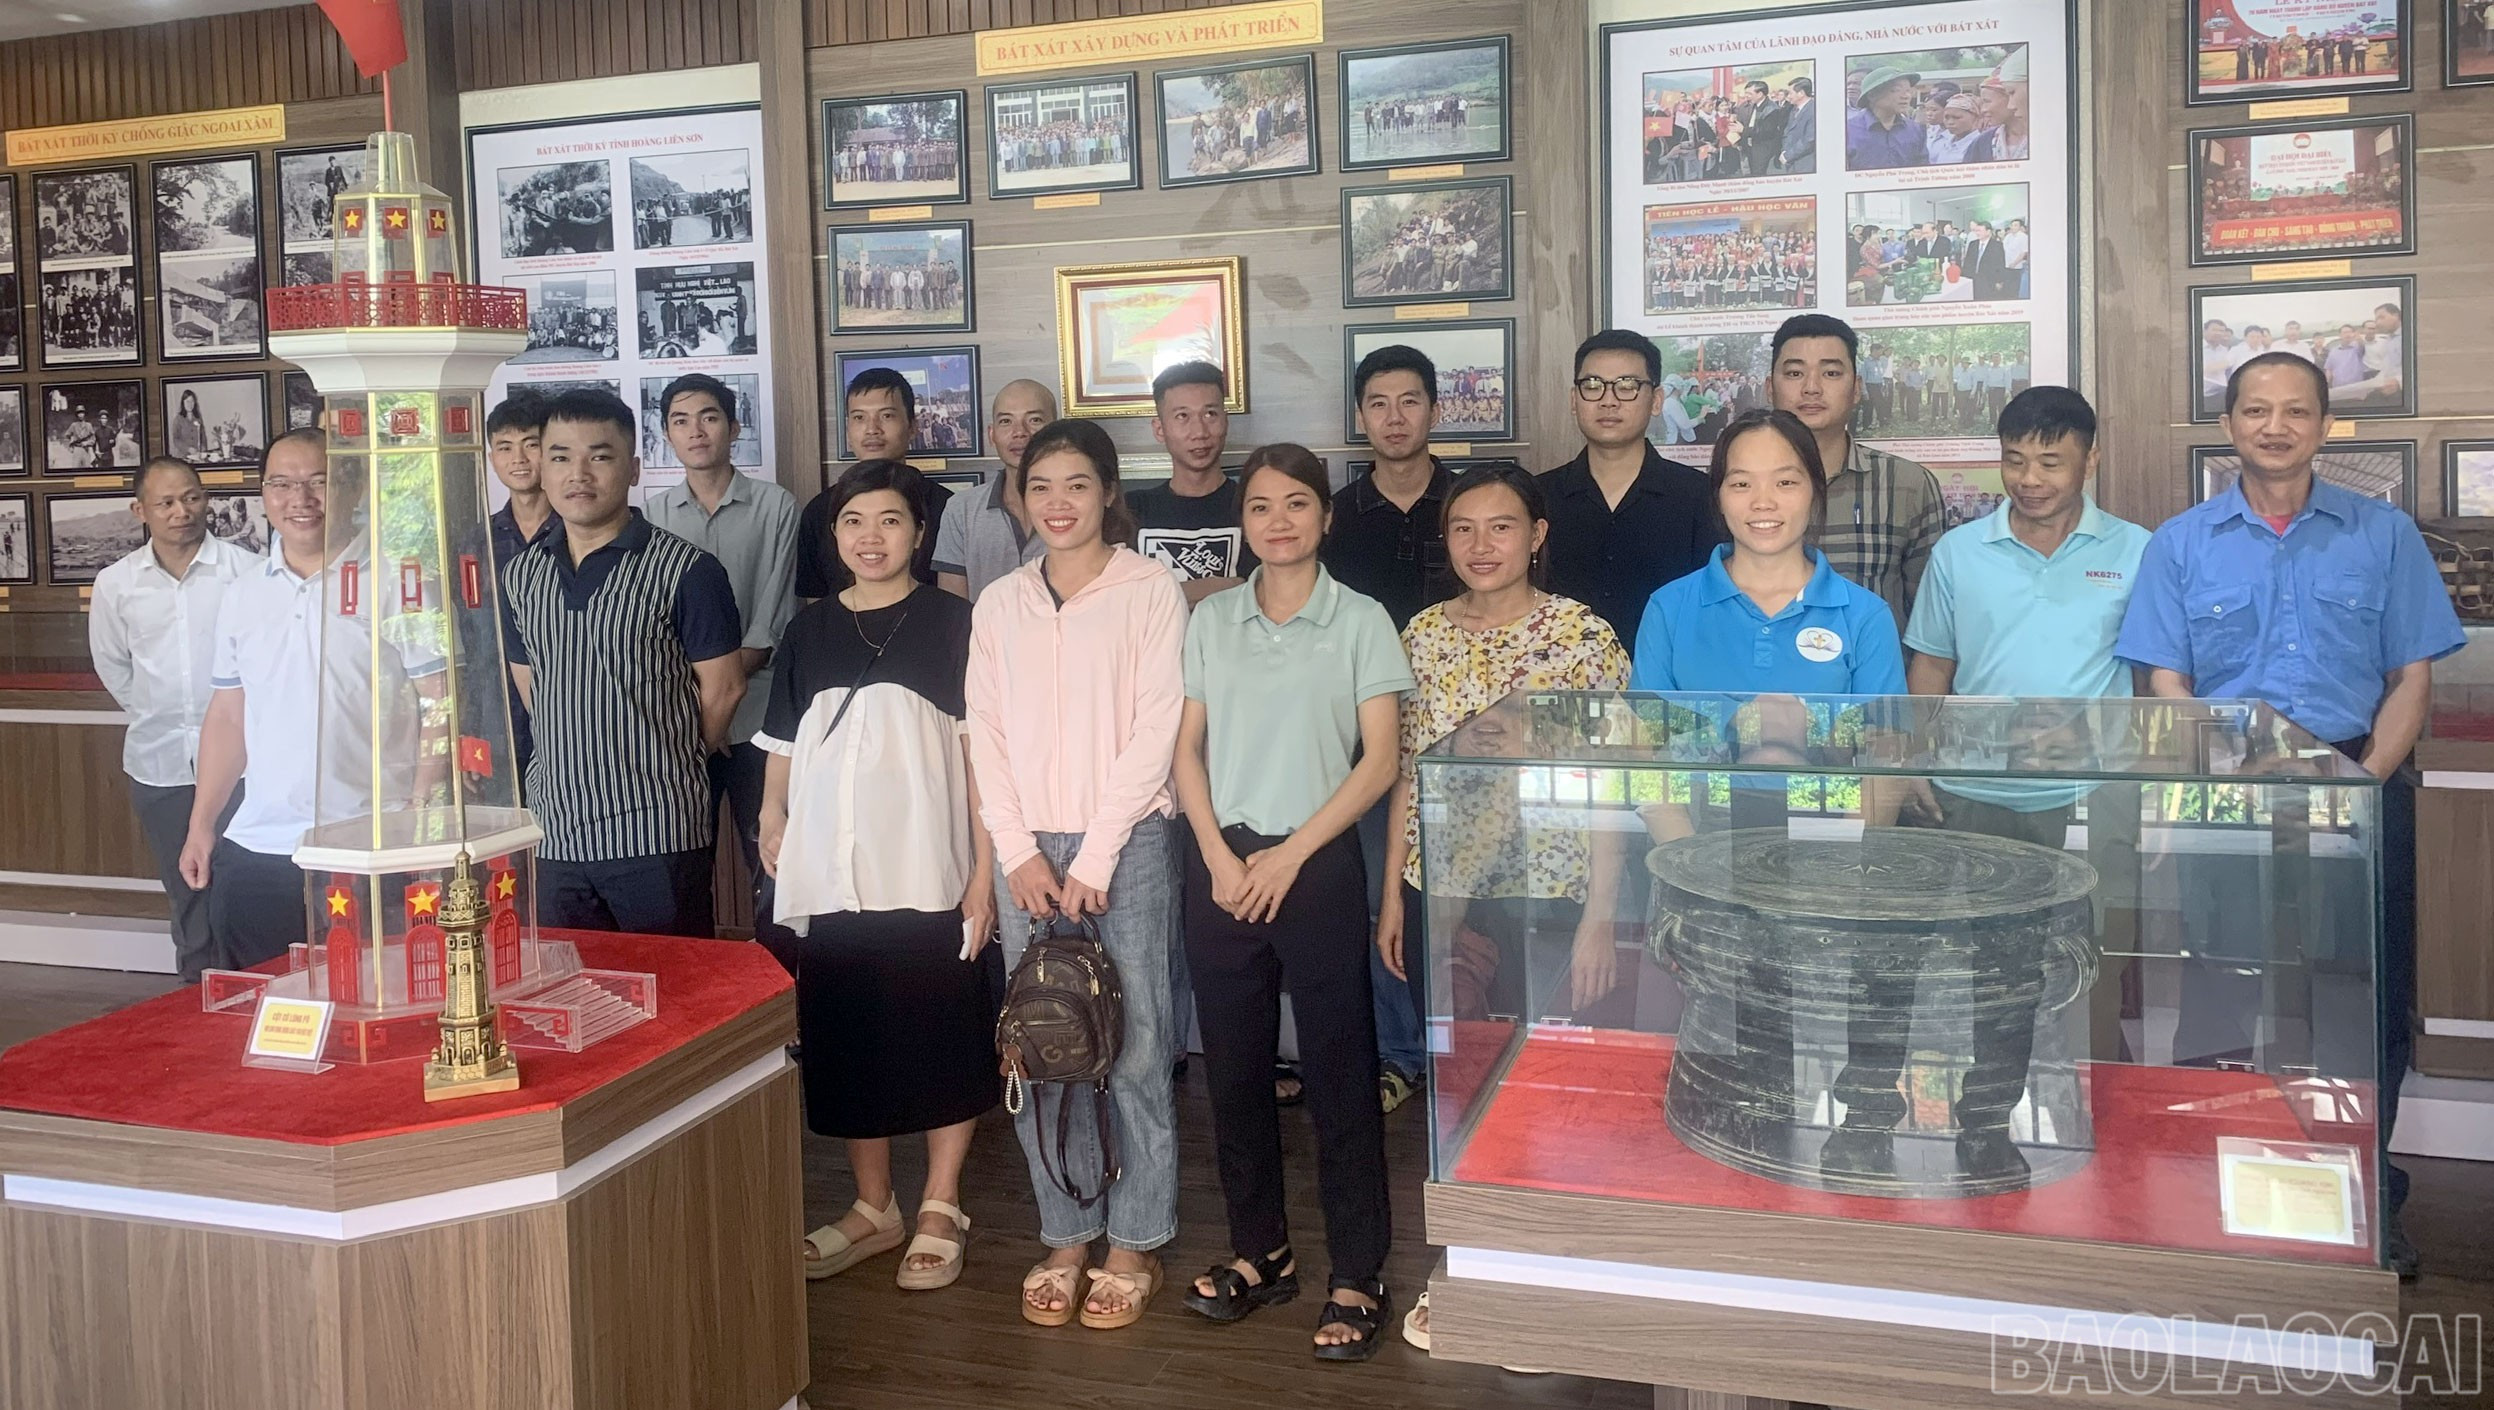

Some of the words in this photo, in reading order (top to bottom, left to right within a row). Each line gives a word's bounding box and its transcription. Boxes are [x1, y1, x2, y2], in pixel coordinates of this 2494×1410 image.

[996, 42, 1029, 61] BÁT
[1033, 38, 1068, 57] XÁT
[1071, 34, 1106, 54] XÂY
[1112, 31, 1160, 52] DỰNG
[1165, 24, 1191, 45] VÀ
[1193, 20, 1240, 41] PHÁT
[1244, 13, 1300, 36] TRIỂN
[1669, 47, 1683, 57] SỰ
[1685, 44, 1715, 56] QUAN
[1717, 39, 1742, 52] TÂM
[1744, 37, 1766, 50] CỦA
[1769, 35, 1800, 48] LÃNH
[1802, 33, 1826, 46] ĐẠO
[1865, 28, 1889, 40] NHÀ
[1892, 23, 1924, 37] NƯỚC
[1927, 21, 1948, 34] VỚI
[1950, 20, 1973, 33] BÁT
[1975, 19, 2000, 31] XÁT
[121, 123, 164, 142] CHỐNG
[167, 121, 199, 140] GIẶC
[242, 114, 273, 132] XÂM
[685, 132, 703, 143] SƠN
[1682, 207, 1705, 217] HỌC
[1758, 202, 1781, 212] HỌC
